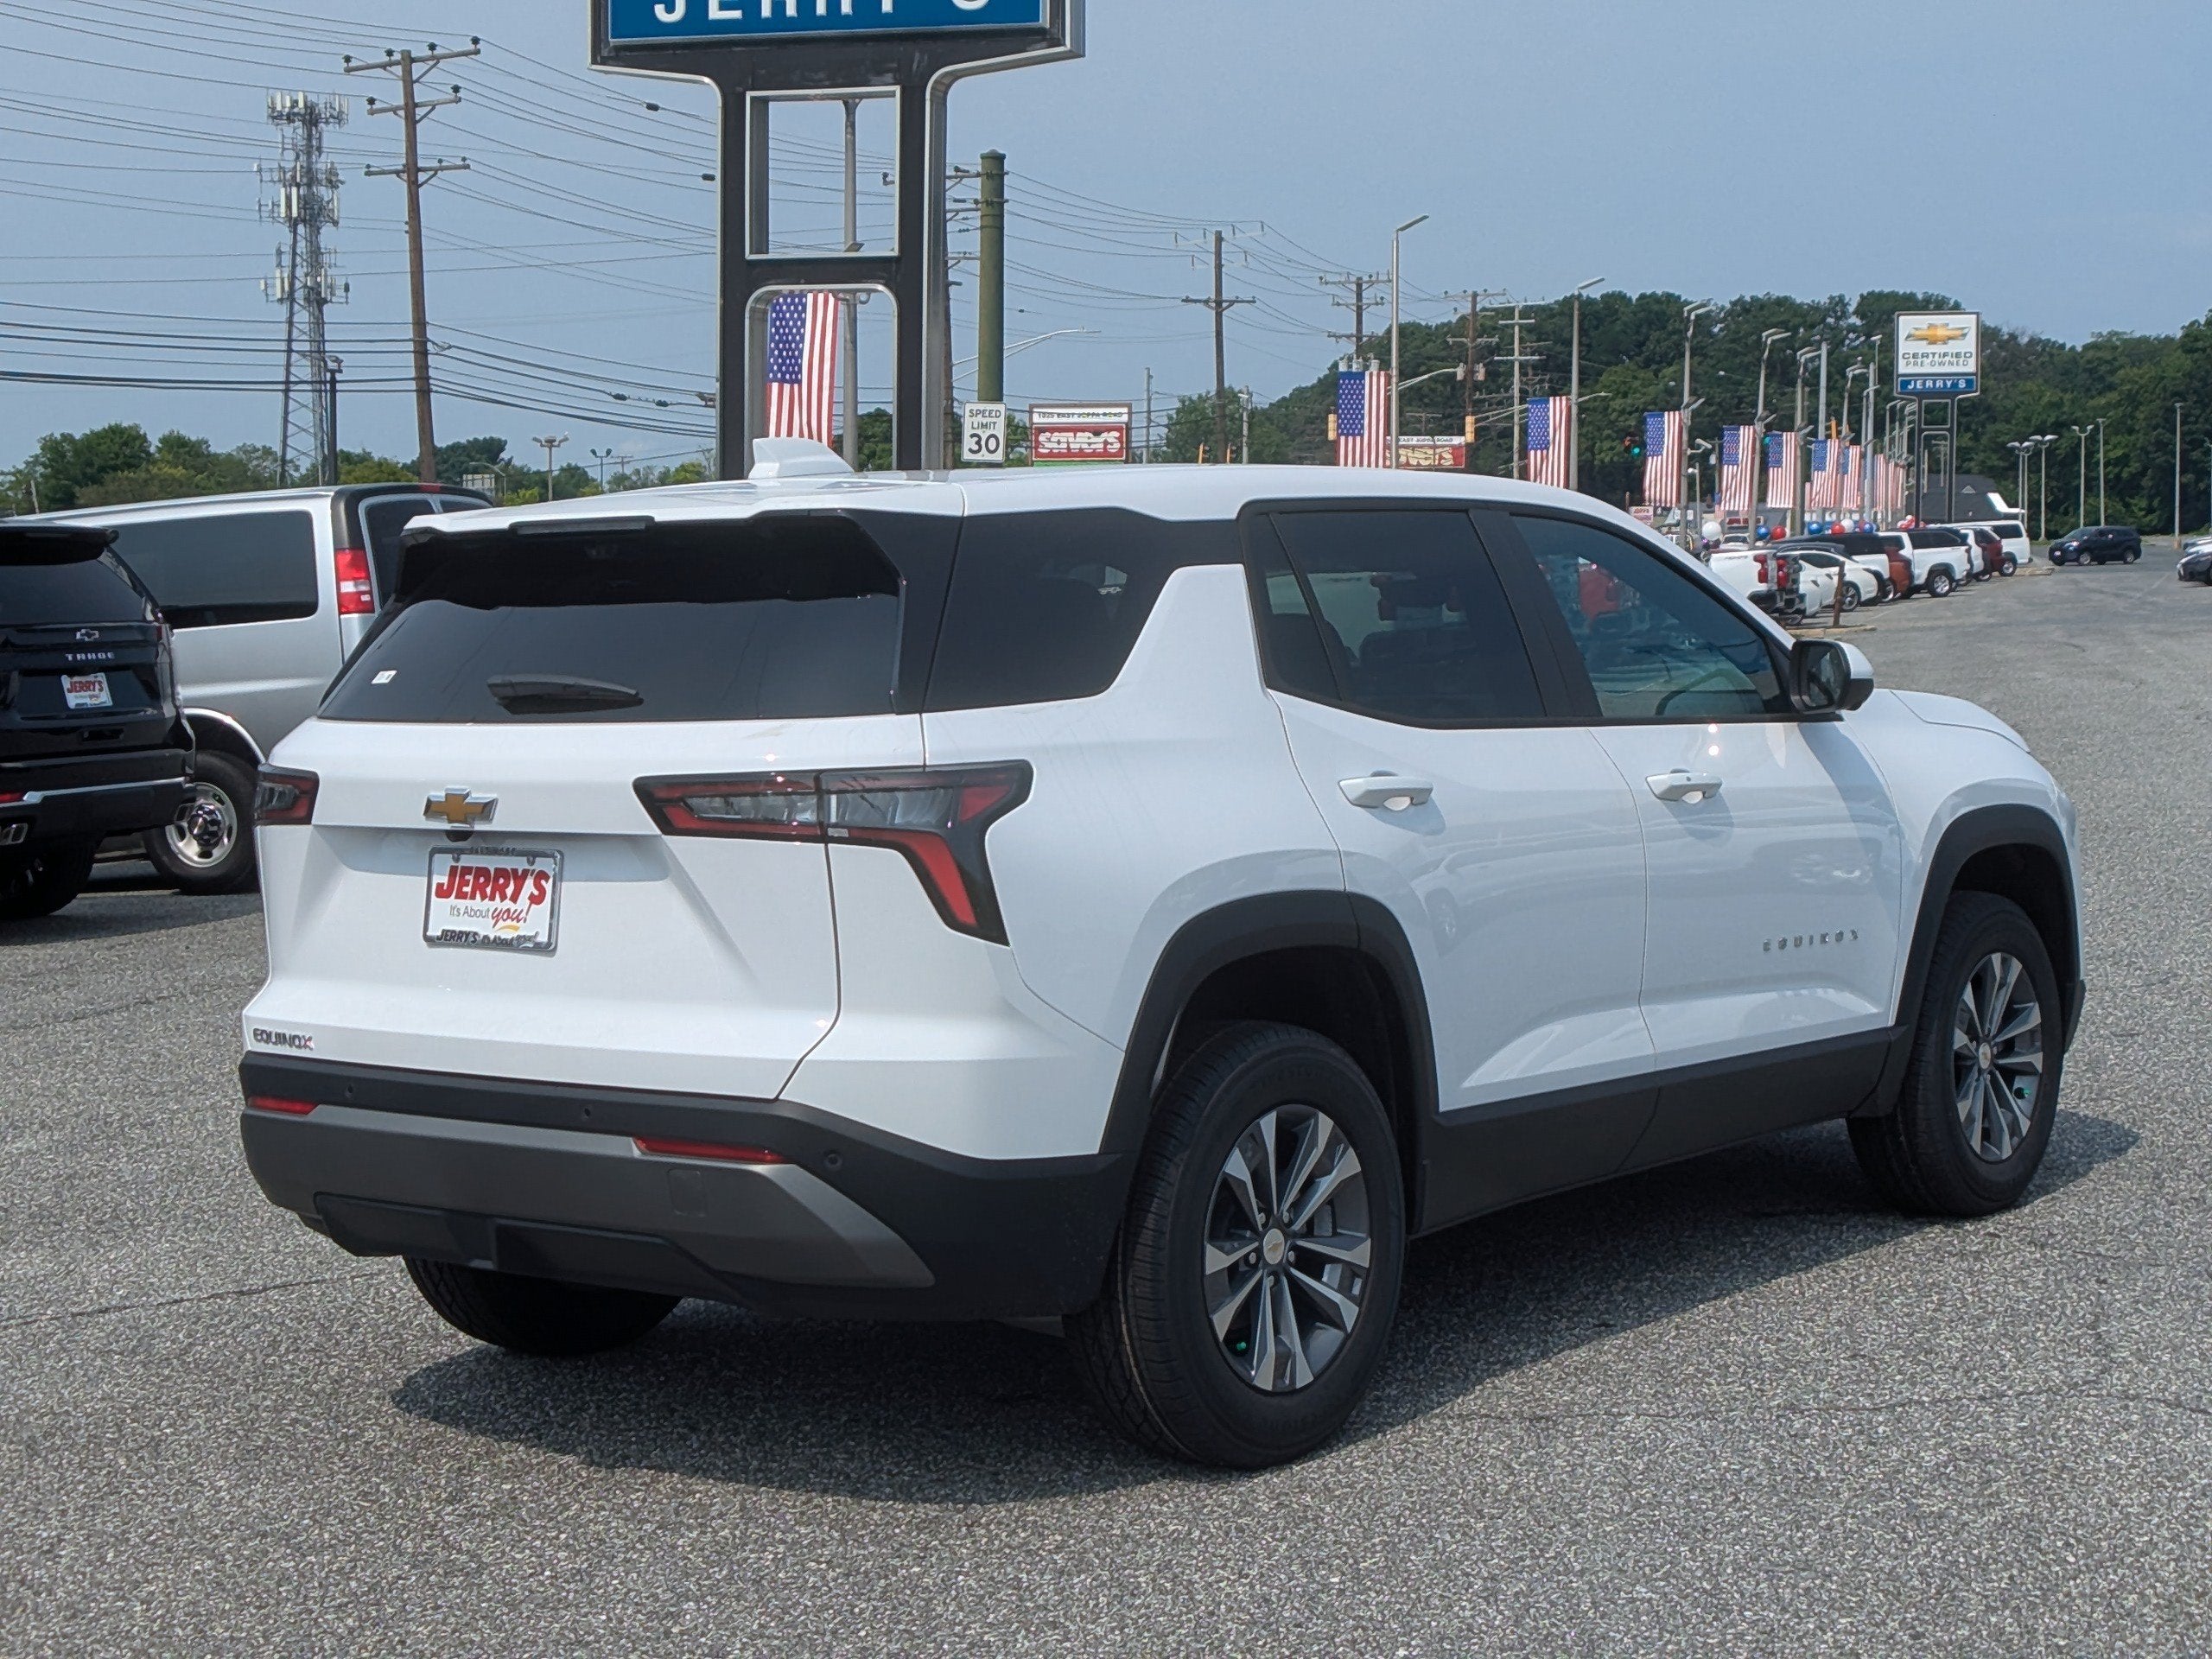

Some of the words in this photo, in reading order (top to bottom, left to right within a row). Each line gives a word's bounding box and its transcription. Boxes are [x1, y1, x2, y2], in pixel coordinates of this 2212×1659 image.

[1902, 351, 1974, 360] CERTIFIED
[1907, 378, 1967, 390] JERRY'S
[968, 409, 1001, 419] SPEED
[971, 421, 998, 430] LIMIT
[968, 433, 1001, 454] 30
[65, 652, 116, 662] TAHOE
[435, 865, 550, 906] JERRY'S
[449, 905, 461, 917] It's
[462, 906, 490, 918] About
[491, 902, 532, 929] you!
[436, 928, 480, 944] JERRY'S
[1763, 928, 1859, 952] EQUINOX
[253, 1027, 314, 1052] EQUINOX
